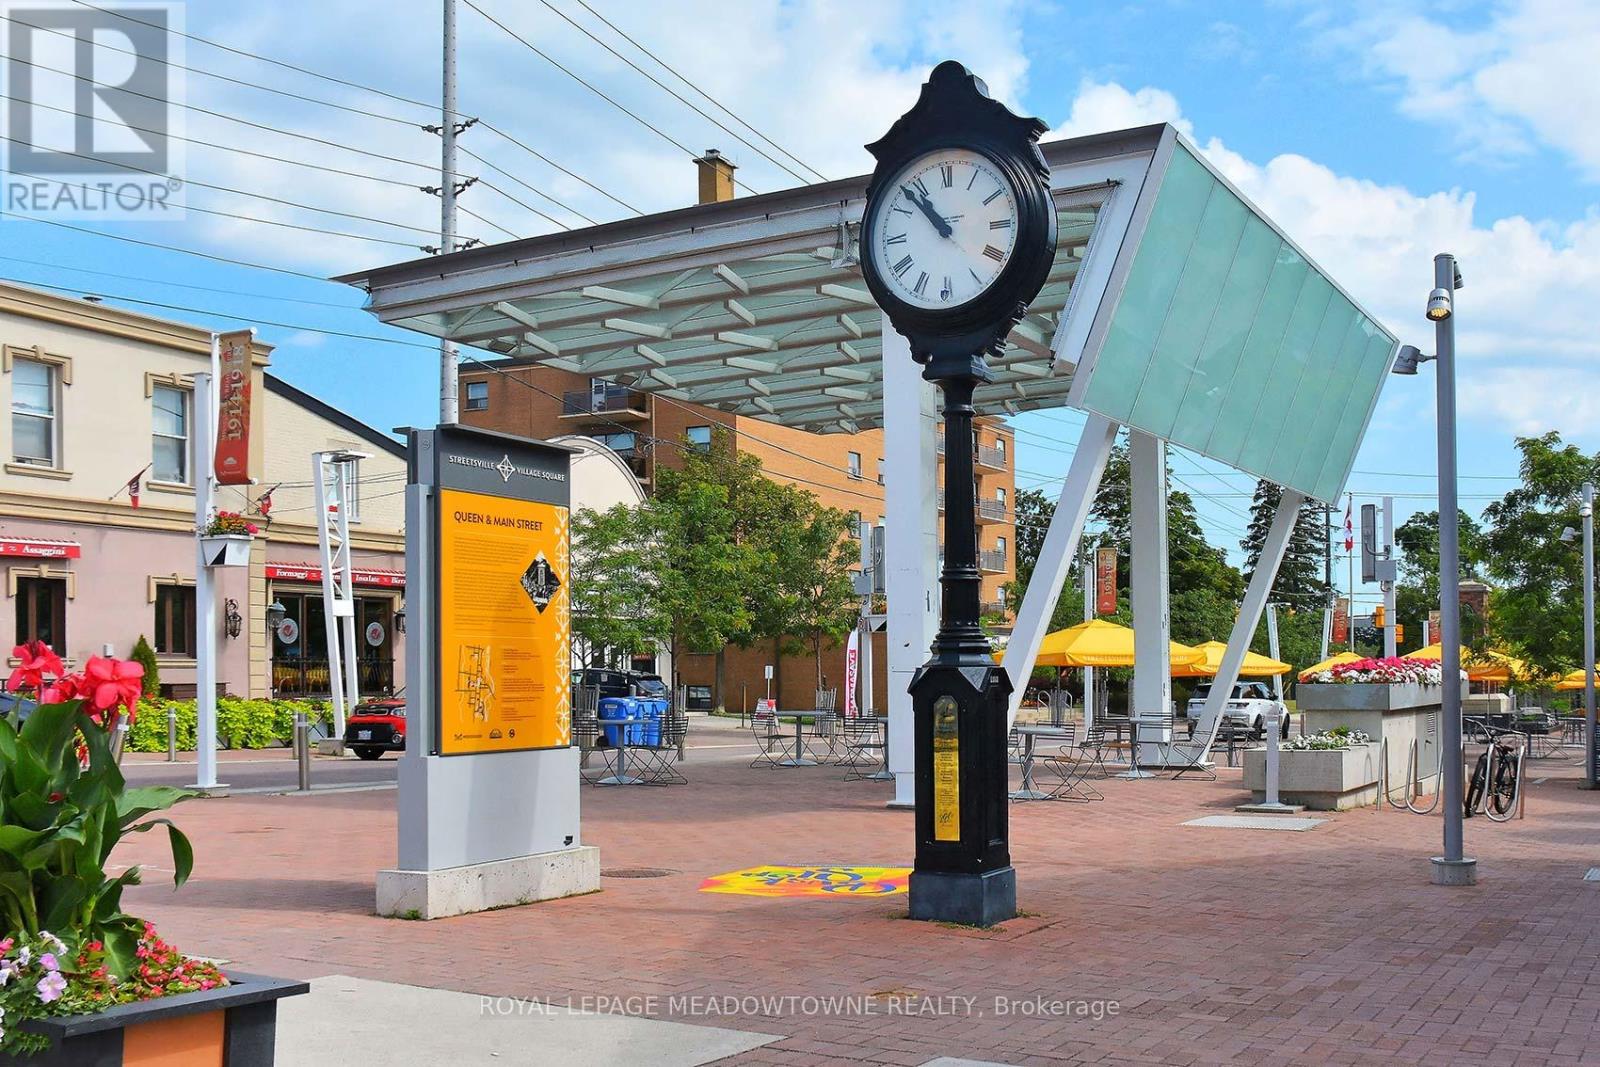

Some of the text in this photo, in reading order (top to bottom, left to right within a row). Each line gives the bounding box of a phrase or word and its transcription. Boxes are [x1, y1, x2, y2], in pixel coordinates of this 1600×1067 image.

[227, 345, 245, 441] 1914-1918
[449, 455, 565, 482] STREETSVILLE VILLAGE SQUARE
[454, 511, 543, 531] QUEEN & MAIN STREET
[276, 568, 308, 580] Formaggi
